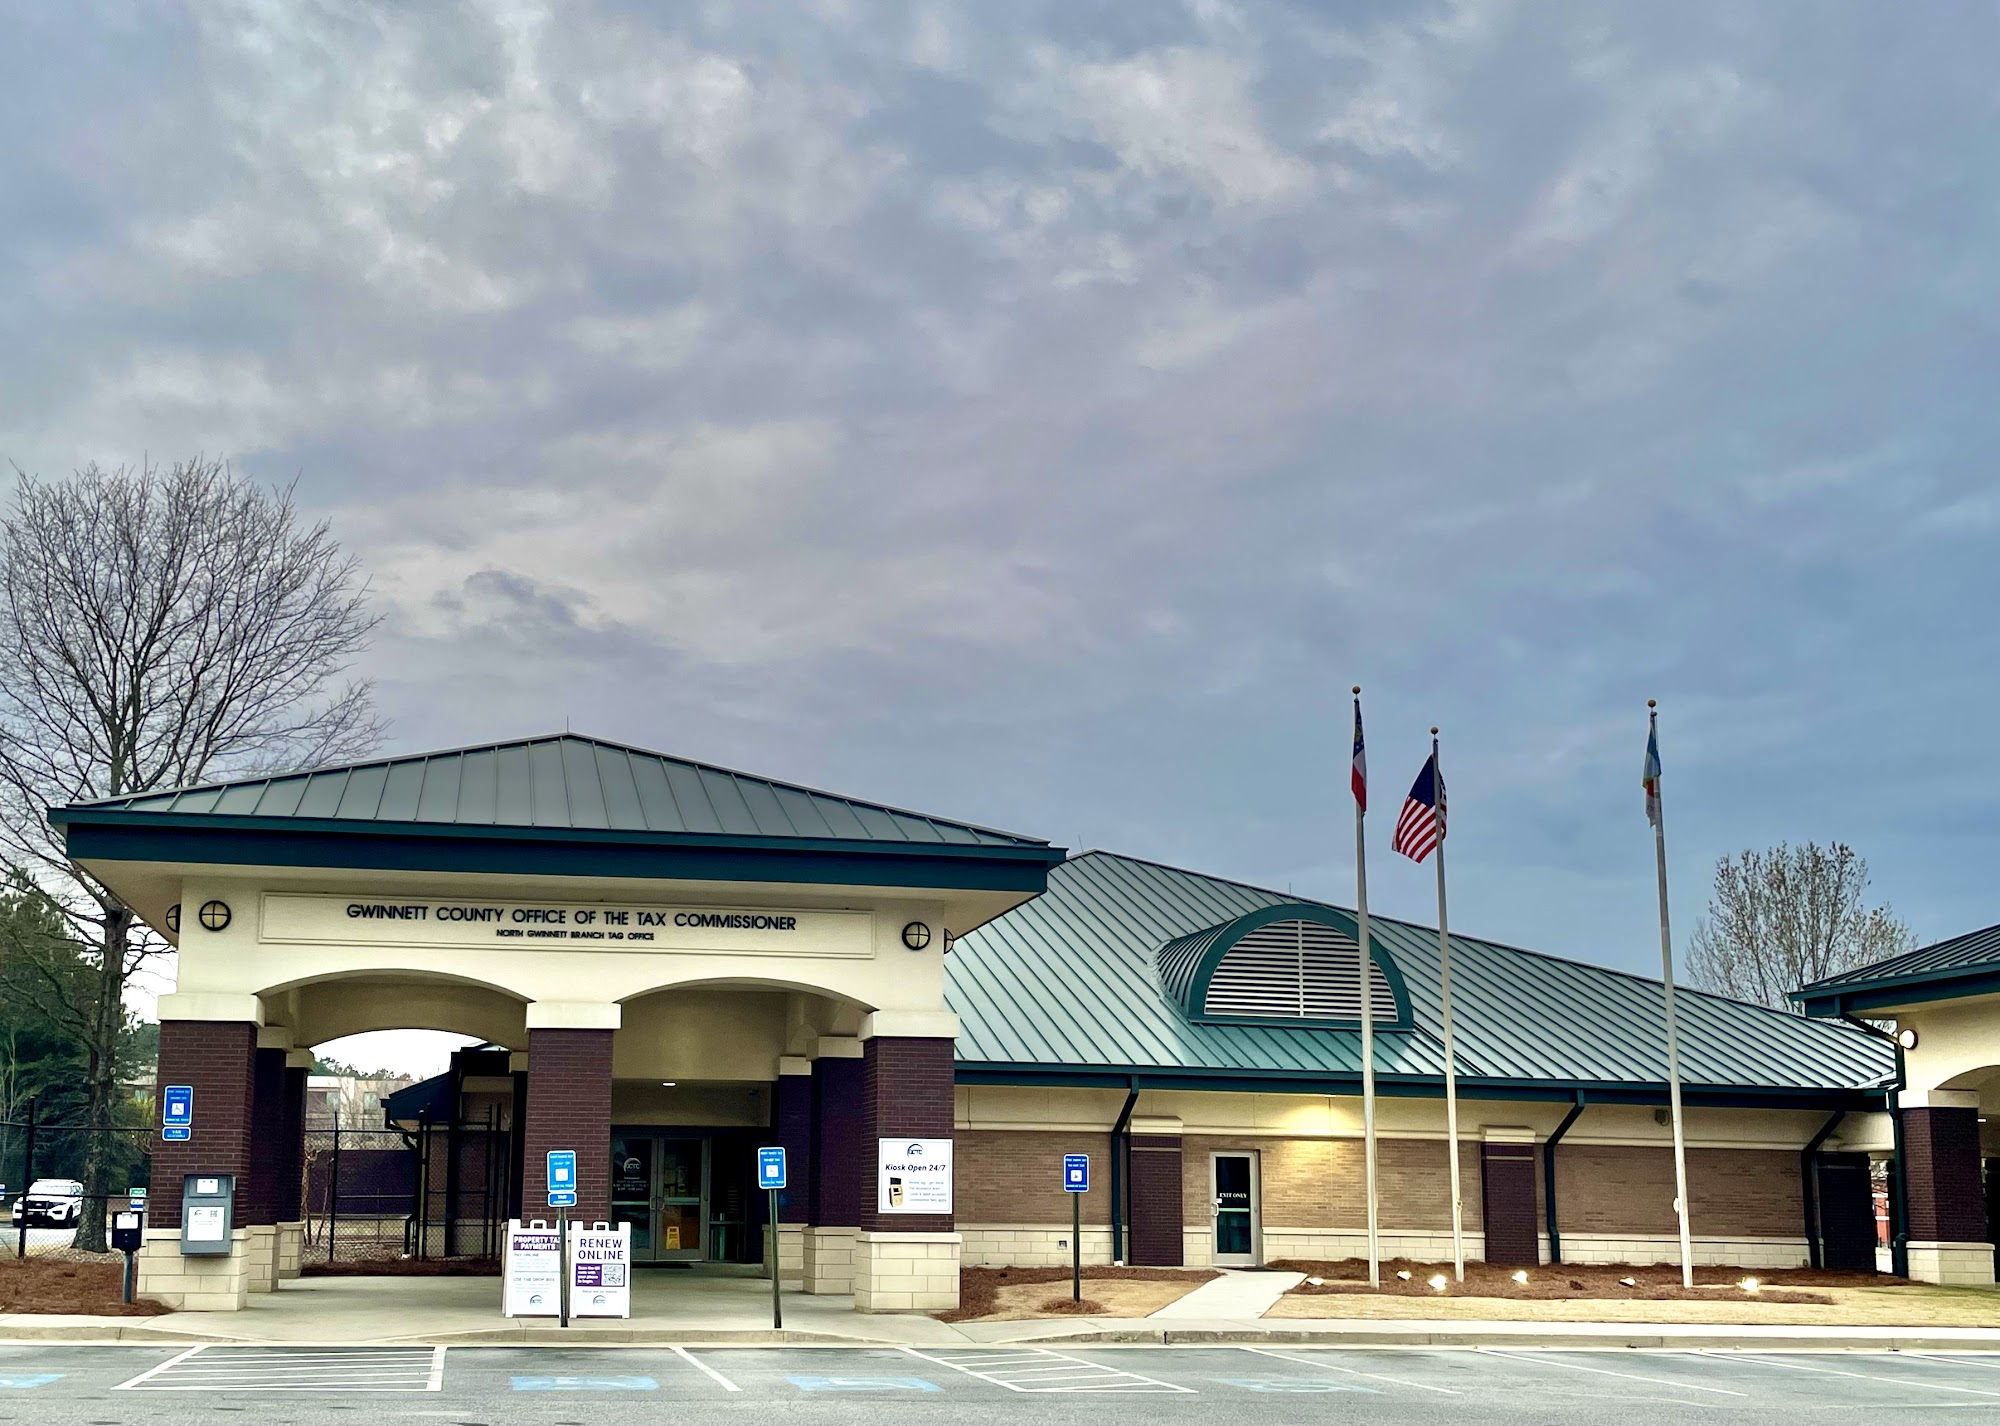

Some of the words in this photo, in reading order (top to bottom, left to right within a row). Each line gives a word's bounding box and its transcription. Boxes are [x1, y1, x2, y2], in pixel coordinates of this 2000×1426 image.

[346, 904, 428, 920] GWINNETT
[436, 906, 504, 922] COUNTY
[512, 908, 566, 923] OFFICE
[574, 910, 596, 924] OF
[604, 911, 629, 925] THE
[637, 912, 666, 926] TAX
[674, 913, 797, 930] COMMISSIONER
[496, 929, 524, 937] NORTH
[527, 930, 567, 938] GWINNETT
[571, 931, 605, 939] BRANCH
[608, 932, 624, 940] TAG
[627, 932, 655, 941] OFFICE
[885, 1163, 906, 1171] Kiosk
[907, 1164, 927, 1173] Open
[579, 1238, 623, 1248] RENEW
[578, 1250, 624, 1260] ONLINE
